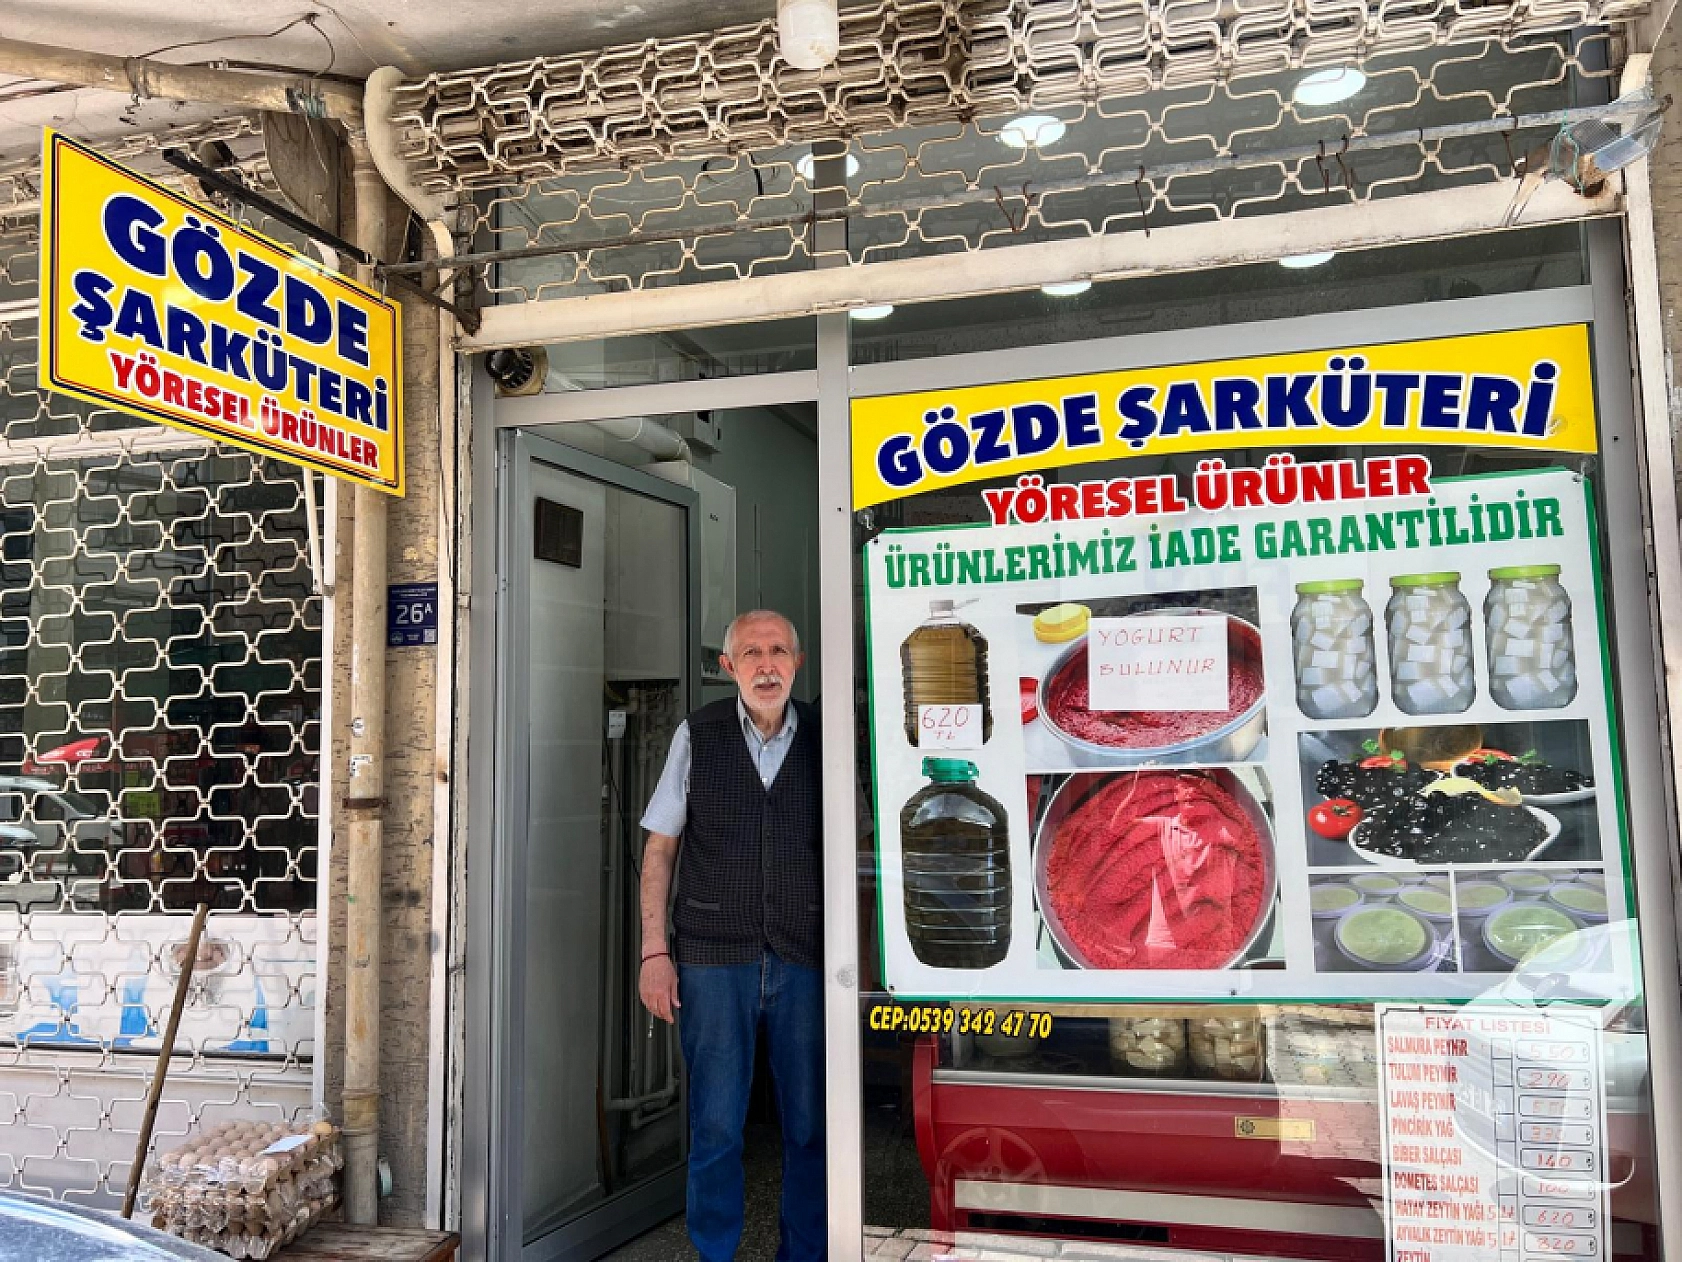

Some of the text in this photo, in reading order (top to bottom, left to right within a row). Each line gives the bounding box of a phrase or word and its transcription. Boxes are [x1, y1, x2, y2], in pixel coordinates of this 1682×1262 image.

[103, 194, 369, 368] GÖZDE
[72, 271, 389, 432] ŞARKÜTERİ
[110, 350, 379, 470] YÖRESEL ÜRÜNLER
[876, 356, 1558, 488] GÖZDE ŞARKÜTERİ
[982, 453, 1432, 526] YÖRESEL ÜRÜNLER
[885, 488, 1565, 590] ÜRÜNLERİMİZ İADE GARANTİLİDİR
[1099, 658, 1216, 676] BULUNUR
[922, 706, 969, 729] 620
[933, 730, 956, 740] TL
[869, 1005, 1053, 1039] CEP:0539 342 47 70
[1388, 1062, 1421, 1082] TULUM
